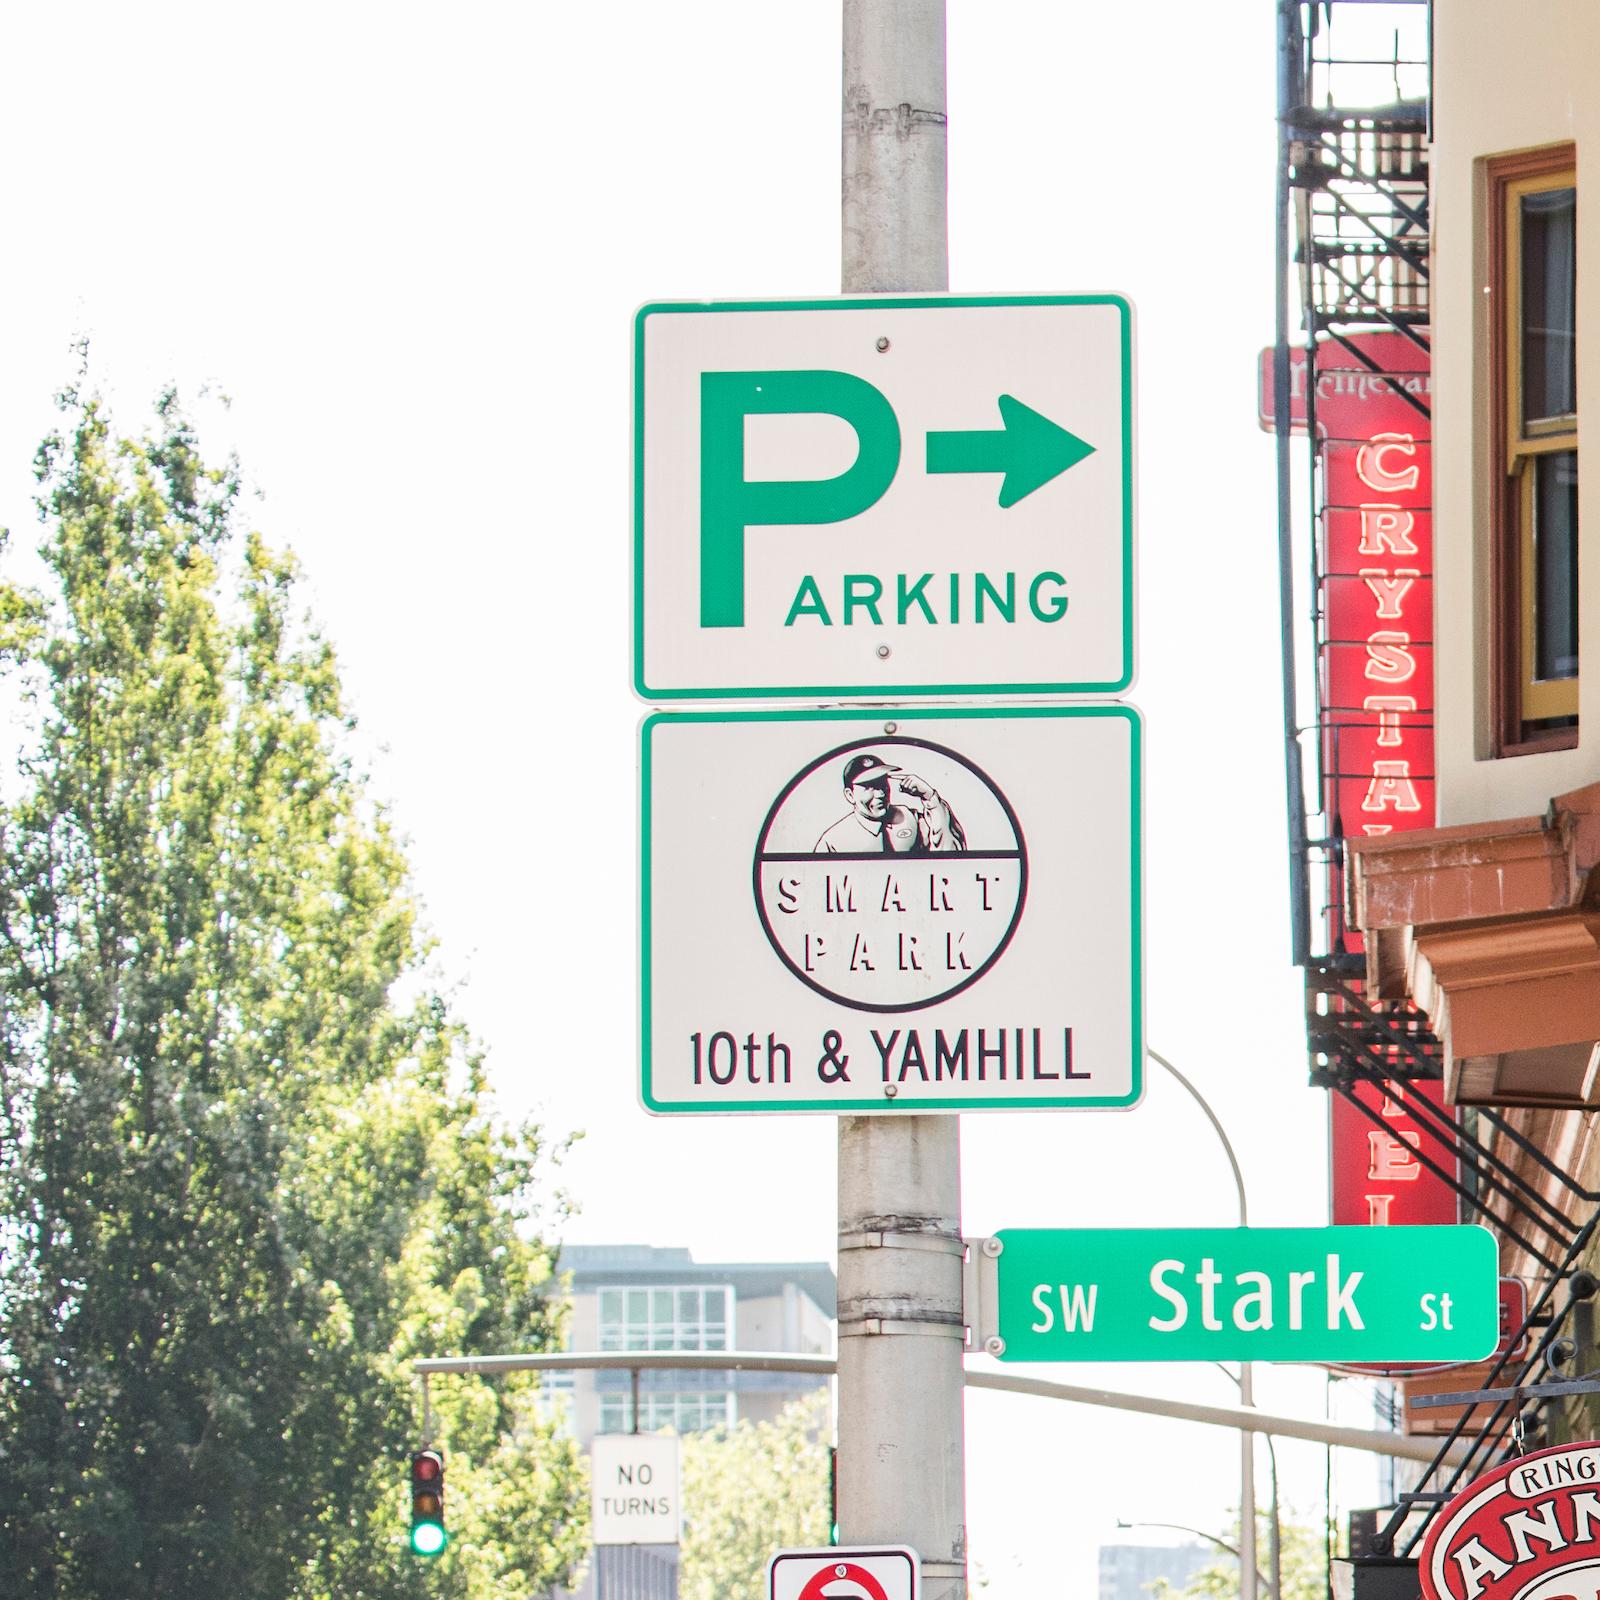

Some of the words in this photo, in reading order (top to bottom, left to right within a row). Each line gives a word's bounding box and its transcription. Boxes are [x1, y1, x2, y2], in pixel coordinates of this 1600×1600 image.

[1356, 432, 1425, 839] CRYSTA
[777, 873, 1002, 914] SMART
[803, 933, 973, 973] PARK
[690, 1032, 792, 1087] 10th
[817, 1031, 851, 1084] &
[869, 1028, 1091, 1083] YAMHILL
[1031, 1284, 1098, 1333] SW
[1148, 1254, 1366, 1332] Stark
[1420, 1292, 1453, 1331] St
[617, 1463, 652, 1485] NO
[602, 1496, 671, 1516] TURNS
